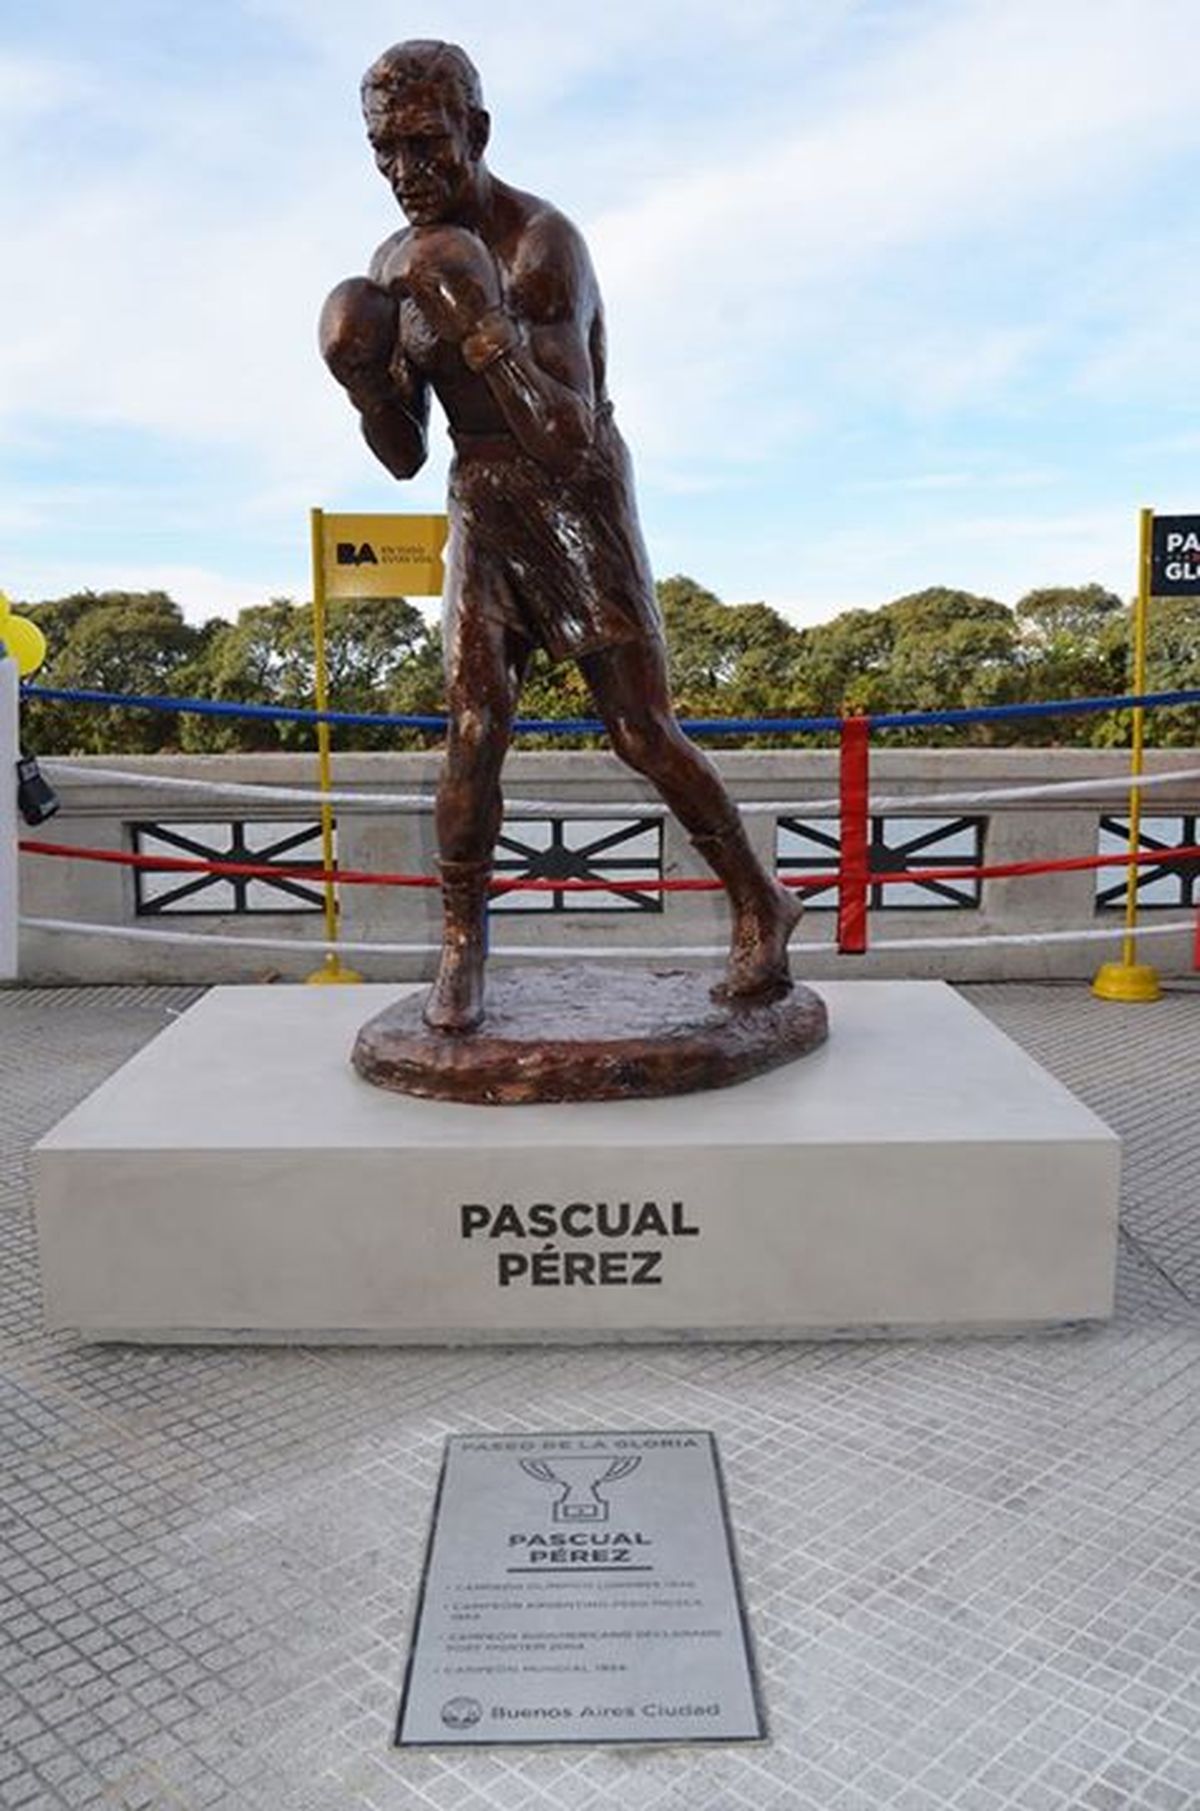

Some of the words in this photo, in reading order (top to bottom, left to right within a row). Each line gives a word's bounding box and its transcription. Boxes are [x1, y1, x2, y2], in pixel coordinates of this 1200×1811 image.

[337, 543, 378, 566] BA
[1165, 562, 1200, 580] GL
[461, 1202, 699, 1238] PASCUAL
[498, 1243, 663, 1286] PÉREZ
[542, 1441, 571, 1449] DE
[579, 1440, 607, 1449] LA
[614, 1438, 699, 1449] GLORIA
[508, 1533, 652, 1547] PASCUAL
[530, 1548, 631, 1563] PÉREZ
[491, 1705, 573, 1719] Buenos
[579, 1705, 636, 1718] Aires
[641, 1702, 721, 1717] Ciudad
